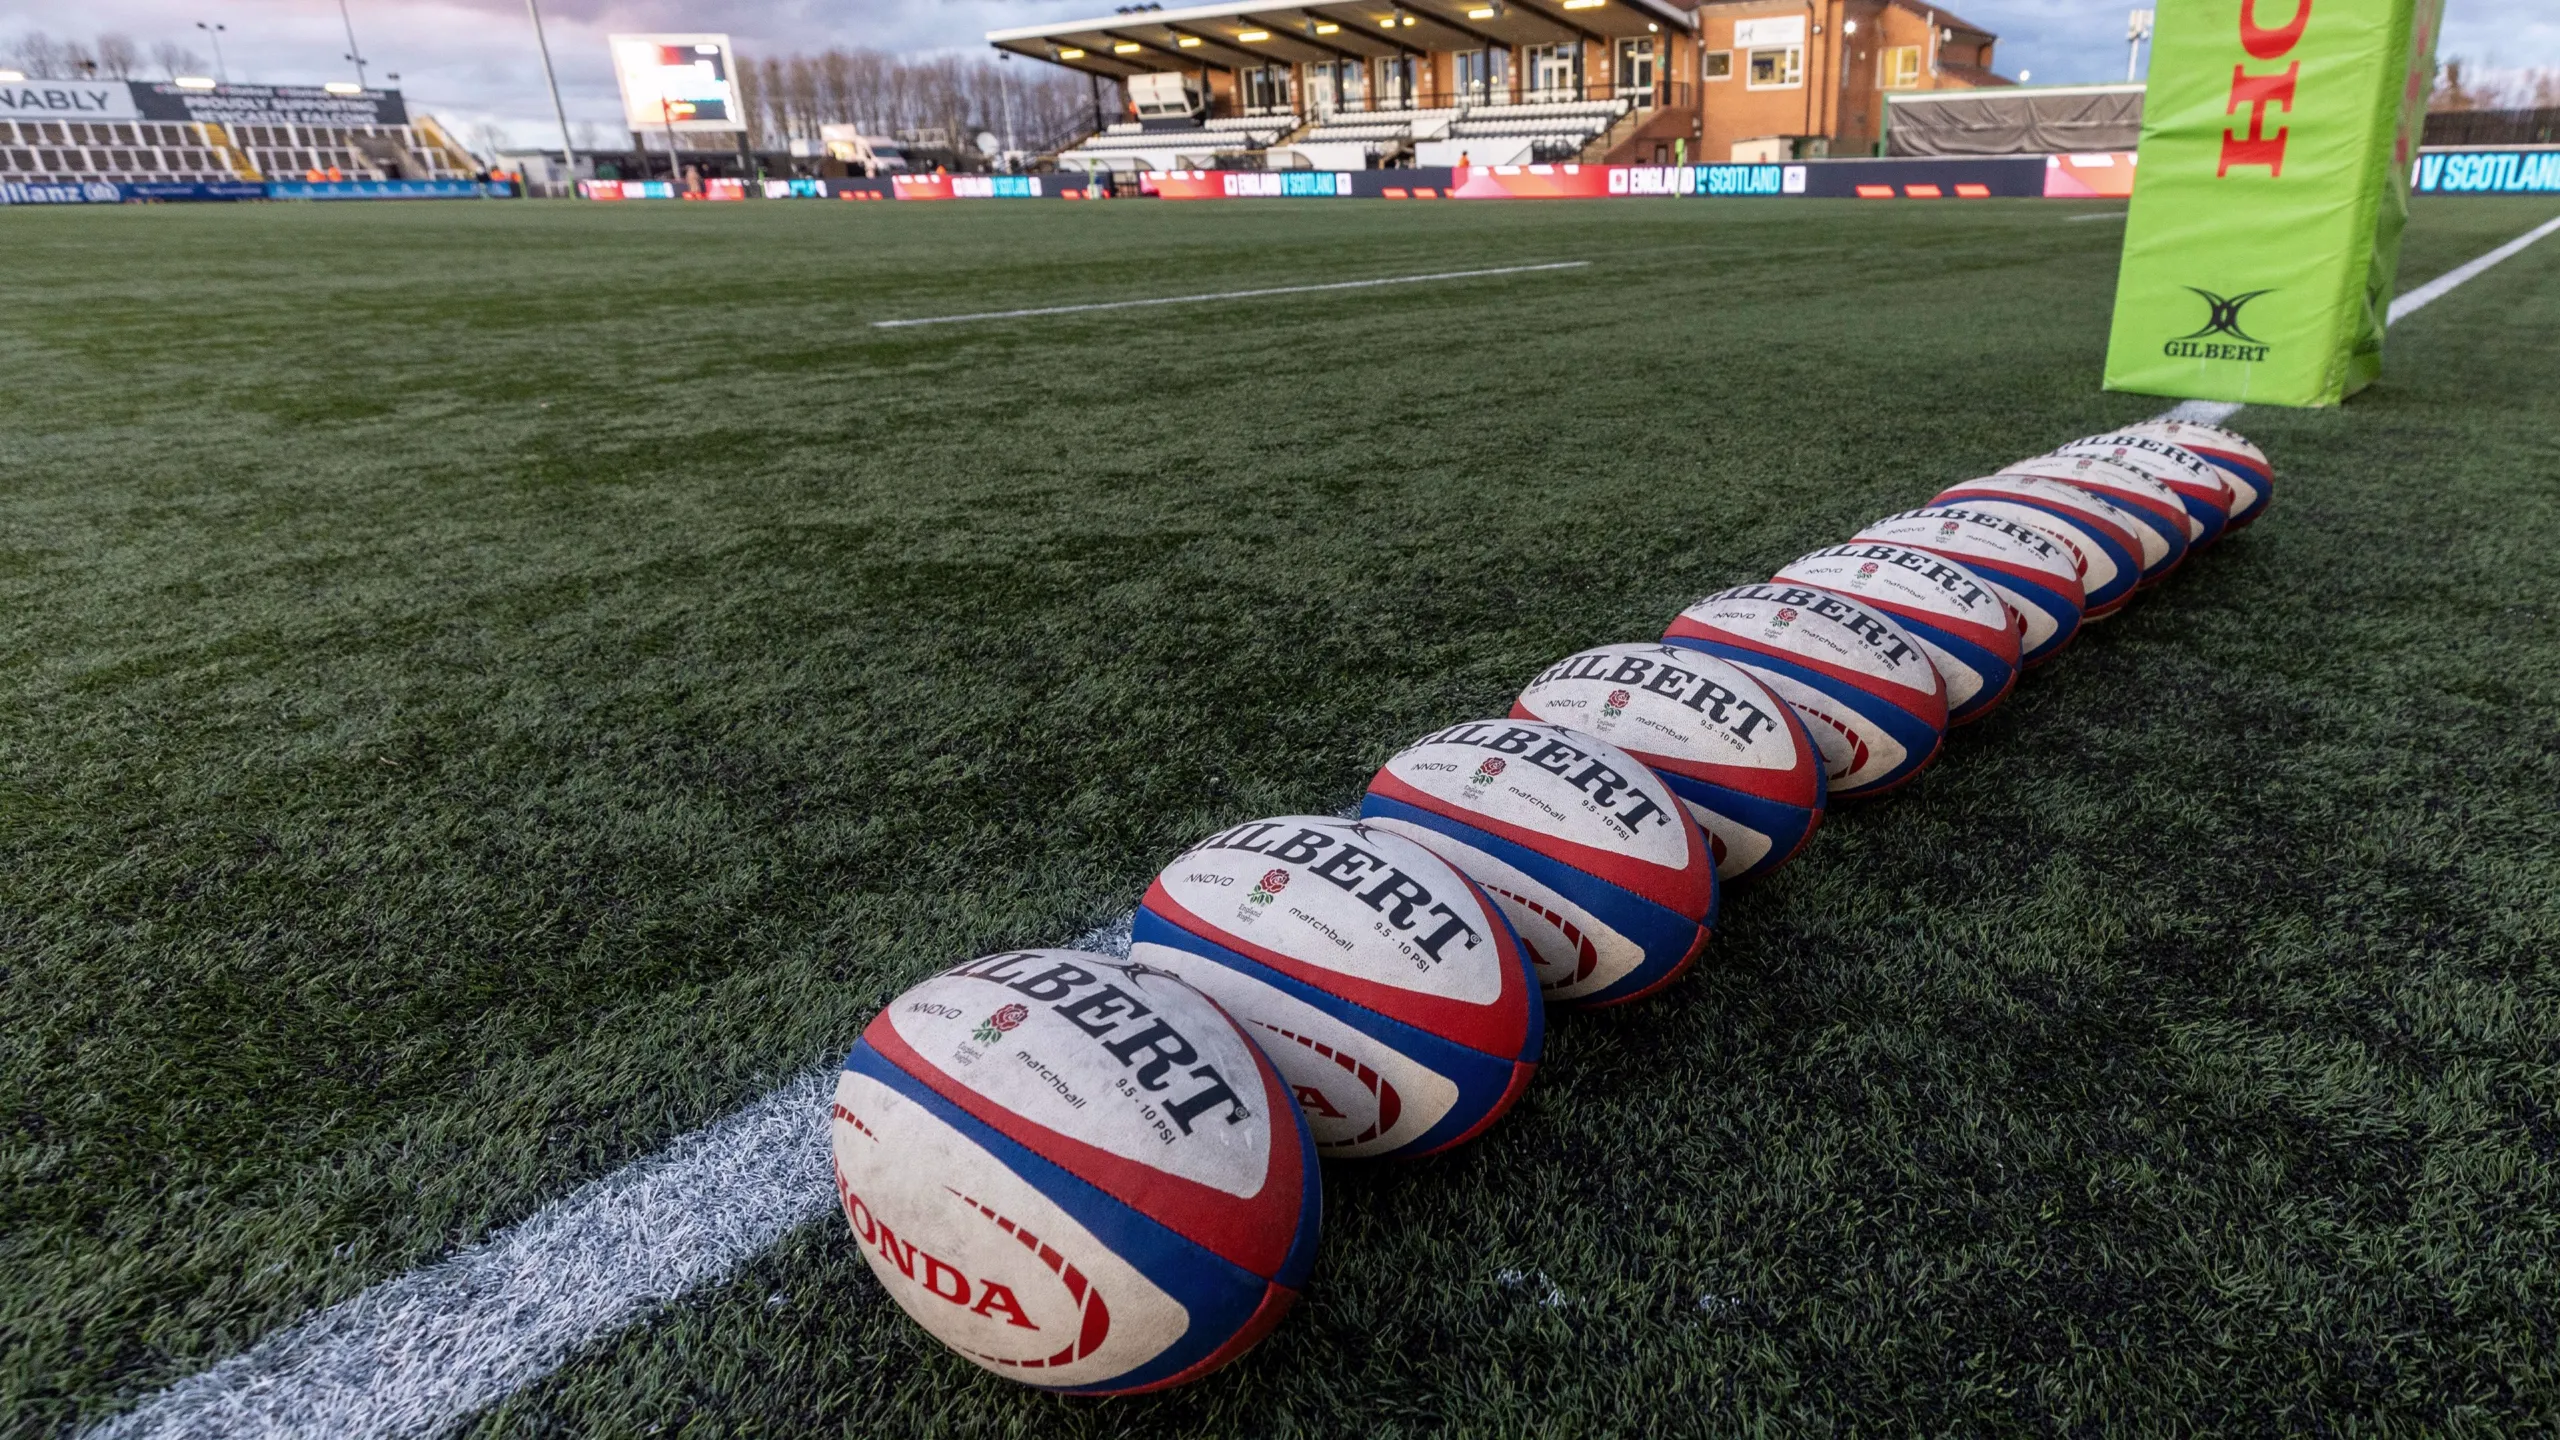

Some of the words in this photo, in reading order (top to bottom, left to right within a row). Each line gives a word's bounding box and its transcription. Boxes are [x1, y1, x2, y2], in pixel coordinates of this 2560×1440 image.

[183, 95, 267, 110] PROUDLY
[271, 98, 378, 113] SUPPORTING
[1630, 168, 1695, 193] ENGLAND
[1709, 166, 1780, 193] SCOTLAND
[2420, 154, 2446, 191] V
[2163, 340, 2271, 362] GILBERT
[1884, 579, 1926, 601] matchball
[1801, 629, 1849, 655] matchball
[1883, 659, 1895, 671] PSI
[1636, 716, 1689, 744] matchball
[1700, 720, 1714, 730] 9.5
[1720, 732, 1730, 741] 10
[1730, 739, 1746, 752] PSI
[1509, 786, 1567, 822] matchball
[1582, 799, 1597, 813] 9.5
[1602, 815, 1614, 827] 10
[1613, 824, 1630, 841] PSI
[1238, 903, 1263, 918] England
[1288, 907, 1355, 952] matchball
[1374, 921, 1392, 937] 9.5
[1398, 941, 1412, 955] 10
[1410, 952, 1430, 973] PSI
[957, 1040, 985, 1060] England
[1016, 1050, 1087, 1110] matchball
[1115, 1078, 1137, 1097] 9.5
[1140, 1104, 1157, 1124] 10
[1152, 1120, 1176, 1145] PSI
